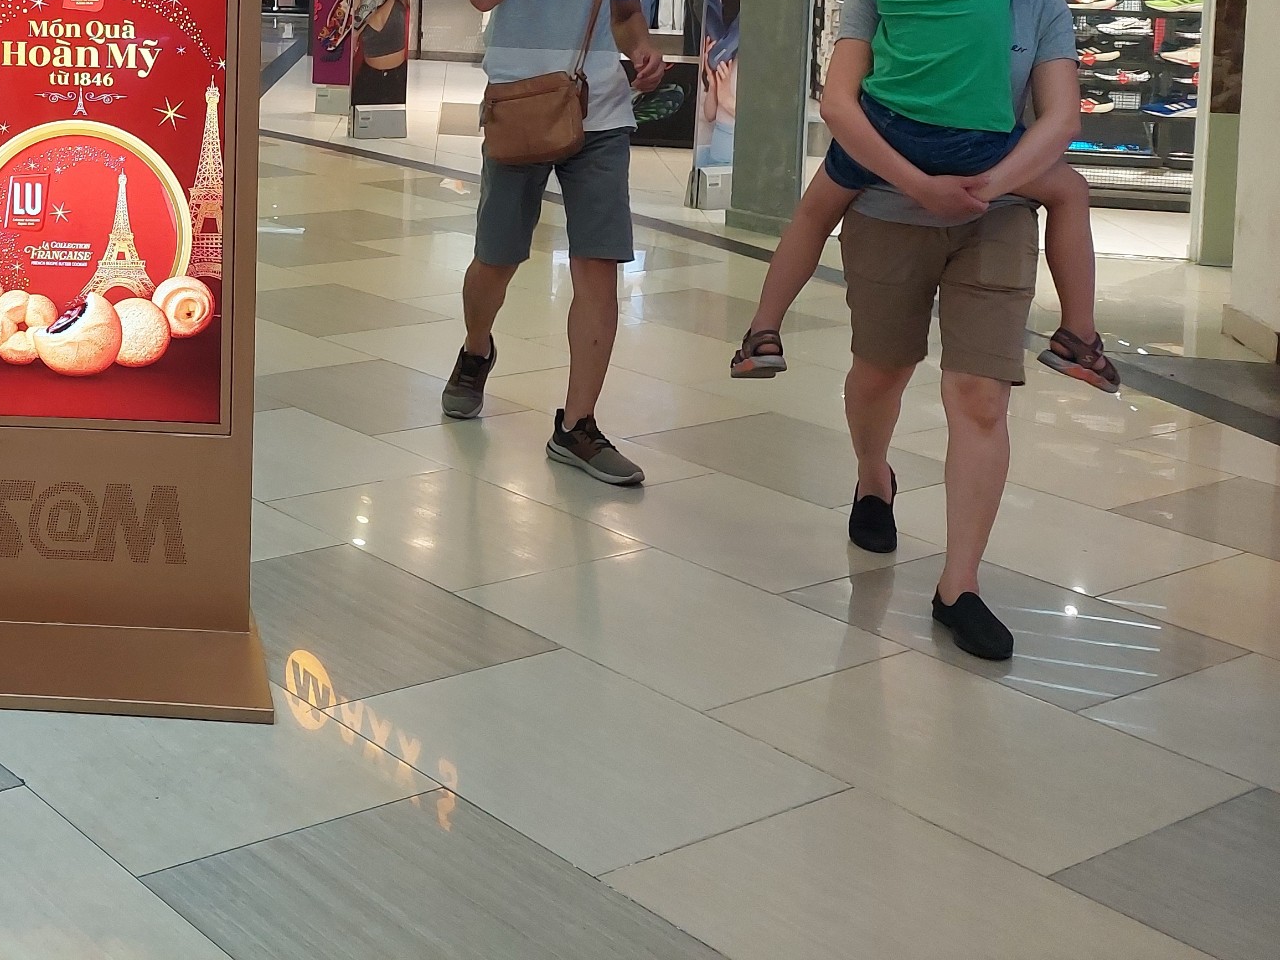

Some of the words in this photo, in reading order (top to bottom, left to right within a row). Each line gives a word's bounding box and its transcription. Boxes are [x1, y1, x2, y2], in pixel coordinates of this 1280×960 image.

[28, 18, 81, 38] Món
[86, 19, 136, 44] Quà
[1, 39, 100, 68] Hoàn
[106, 40, 162, 78] Mỹ
[49, 70, 69, 85] từ
[74, 71, 114, 87] 1846
[13, 182, 42, 216] LU
